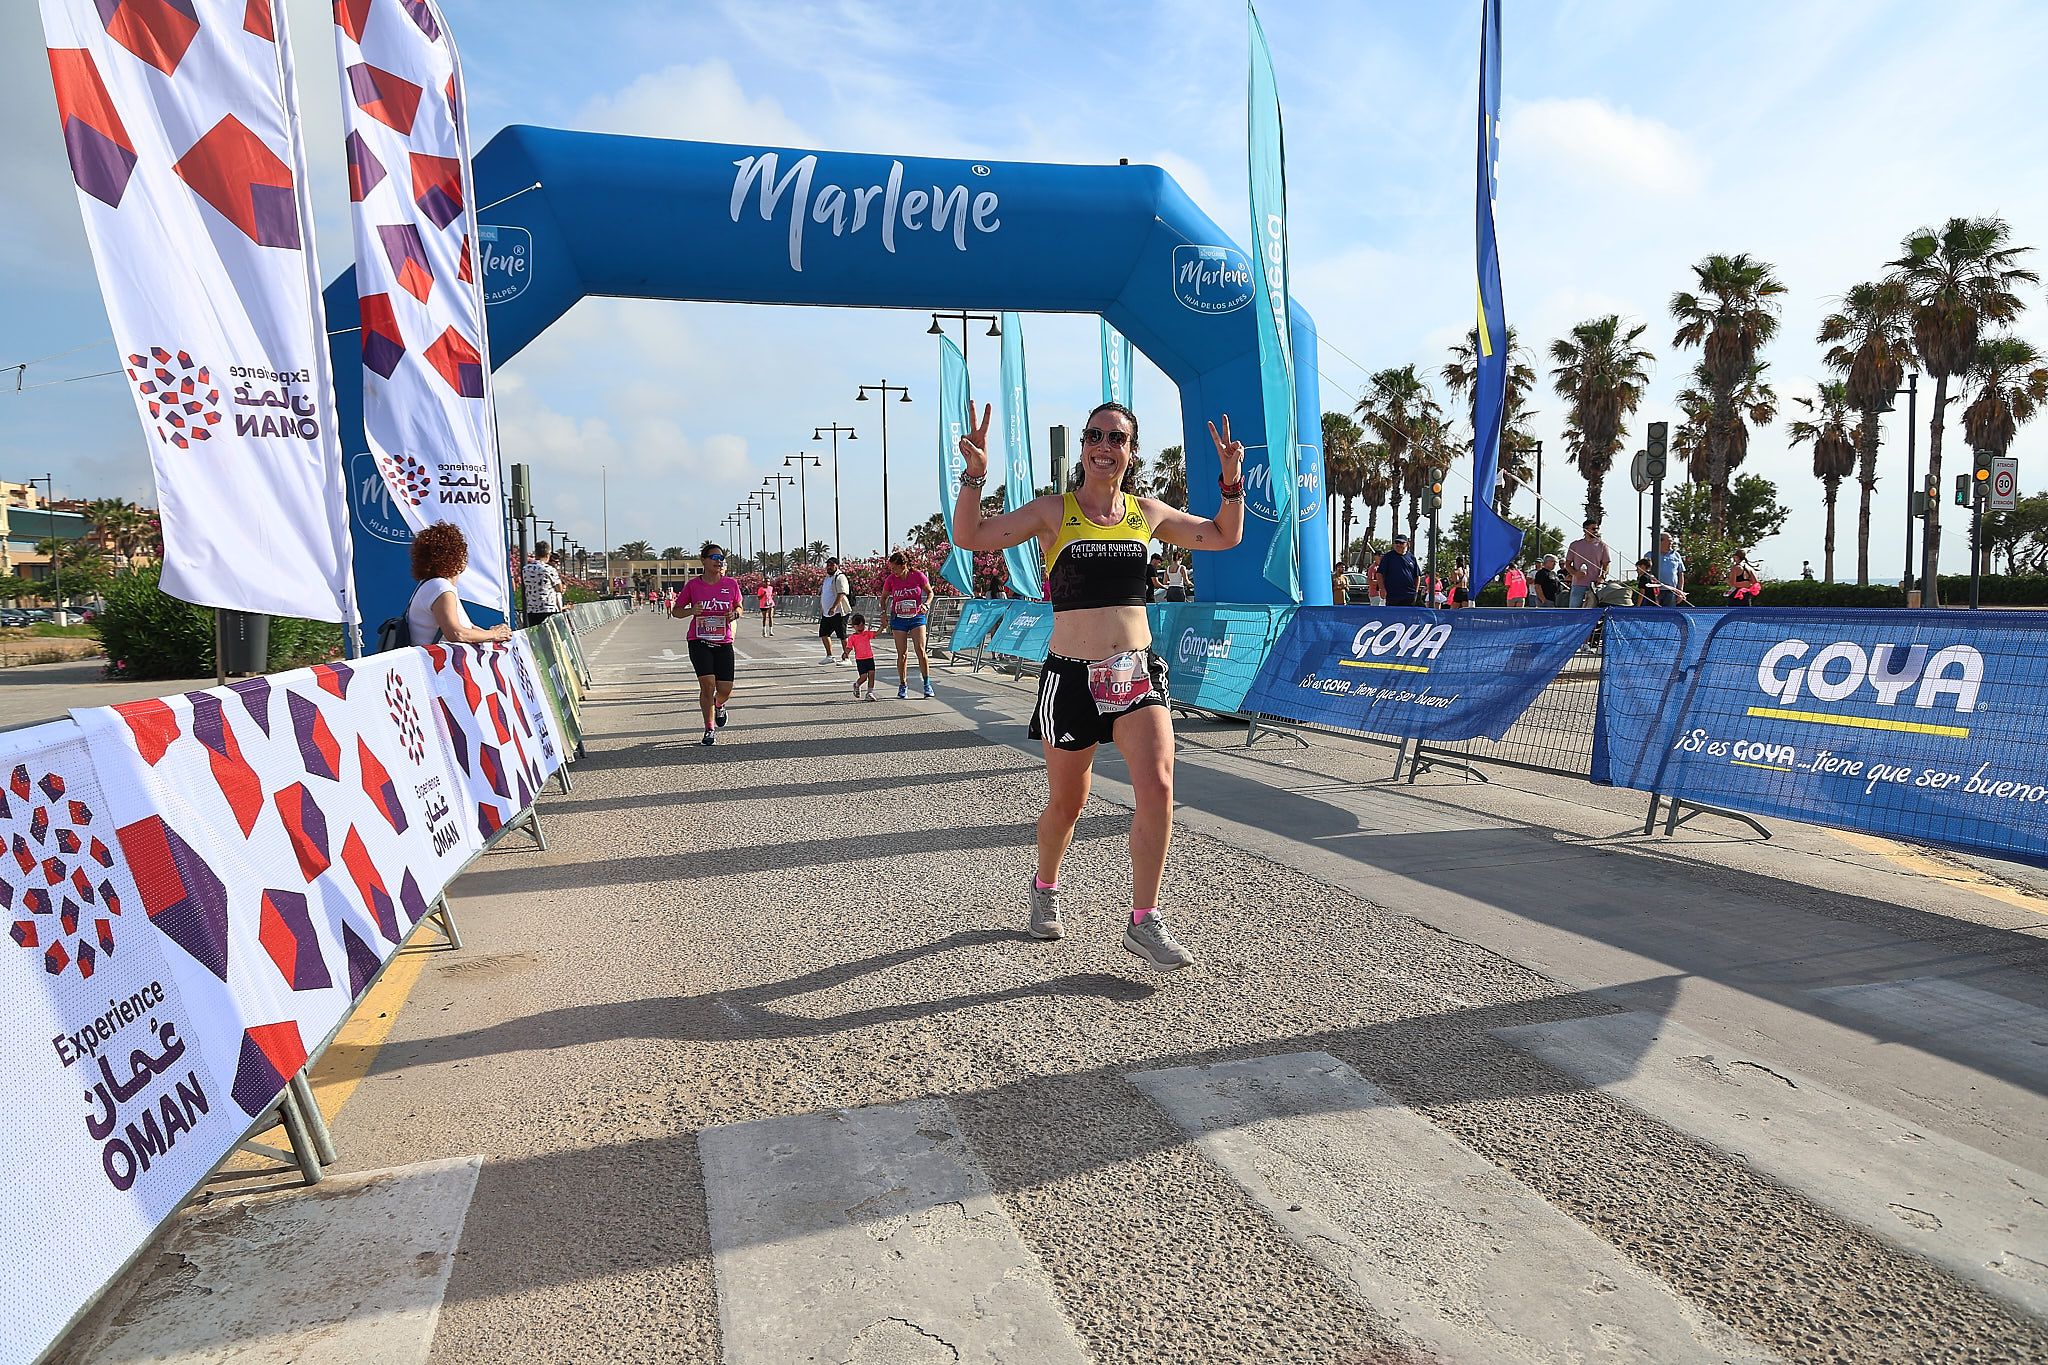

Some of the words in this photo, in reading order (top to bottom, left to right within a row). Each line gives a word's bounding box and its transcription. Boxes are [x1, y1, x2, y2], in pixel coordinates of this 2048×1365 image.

[730, 152, 1001, 272] Marlene
[481, 242, 525, 277] lene
[491, 284, 517, 300] ALPES
[1180, 260, 1249, 296] Marlene
[1183, 293, 1199, 307] HIJA
[1200, 301, 1211, 310] DE
[1212, 302, 1227, 310] LOS
[1228, 293, 1248, 308] ALPES
[1999, 479, 2010, 489] 30
[1253, 501, 1270, 515] HIJA
[1300, 501, 1317, 517] ALPES
[368, 518, 389, 535] HIJA
[391, 529, 406, 538] DE
[1071, 543, 1107, 554] PATERNA
[1108, 543, 1142, 553] RUNNERS
[1178, 627, 1233, 663] Compeed
[1351, 620, 1453, 660] GOYA
[1111, 682, 1132, 694] 016
[1757, 638, 1984, 713] GOYA
[1322, 679, 1351, 693] GOYA
[1372, 687, 1394, 707] que
[1395, 690, 1415, 704] ser
[1413, 686, 1460, 709] bueno!
[1707, 741, 1730, 757] es
[1732, 739, 1795, 766] GOYA
[1865, 763, 1912, 795] que
[1915, 769, 1961, 790] ser
[433, 820, 461, 858] OMAN
[51, 980, 165, 1068] Experience
[102, 1070, 210, 1192] OMAN
